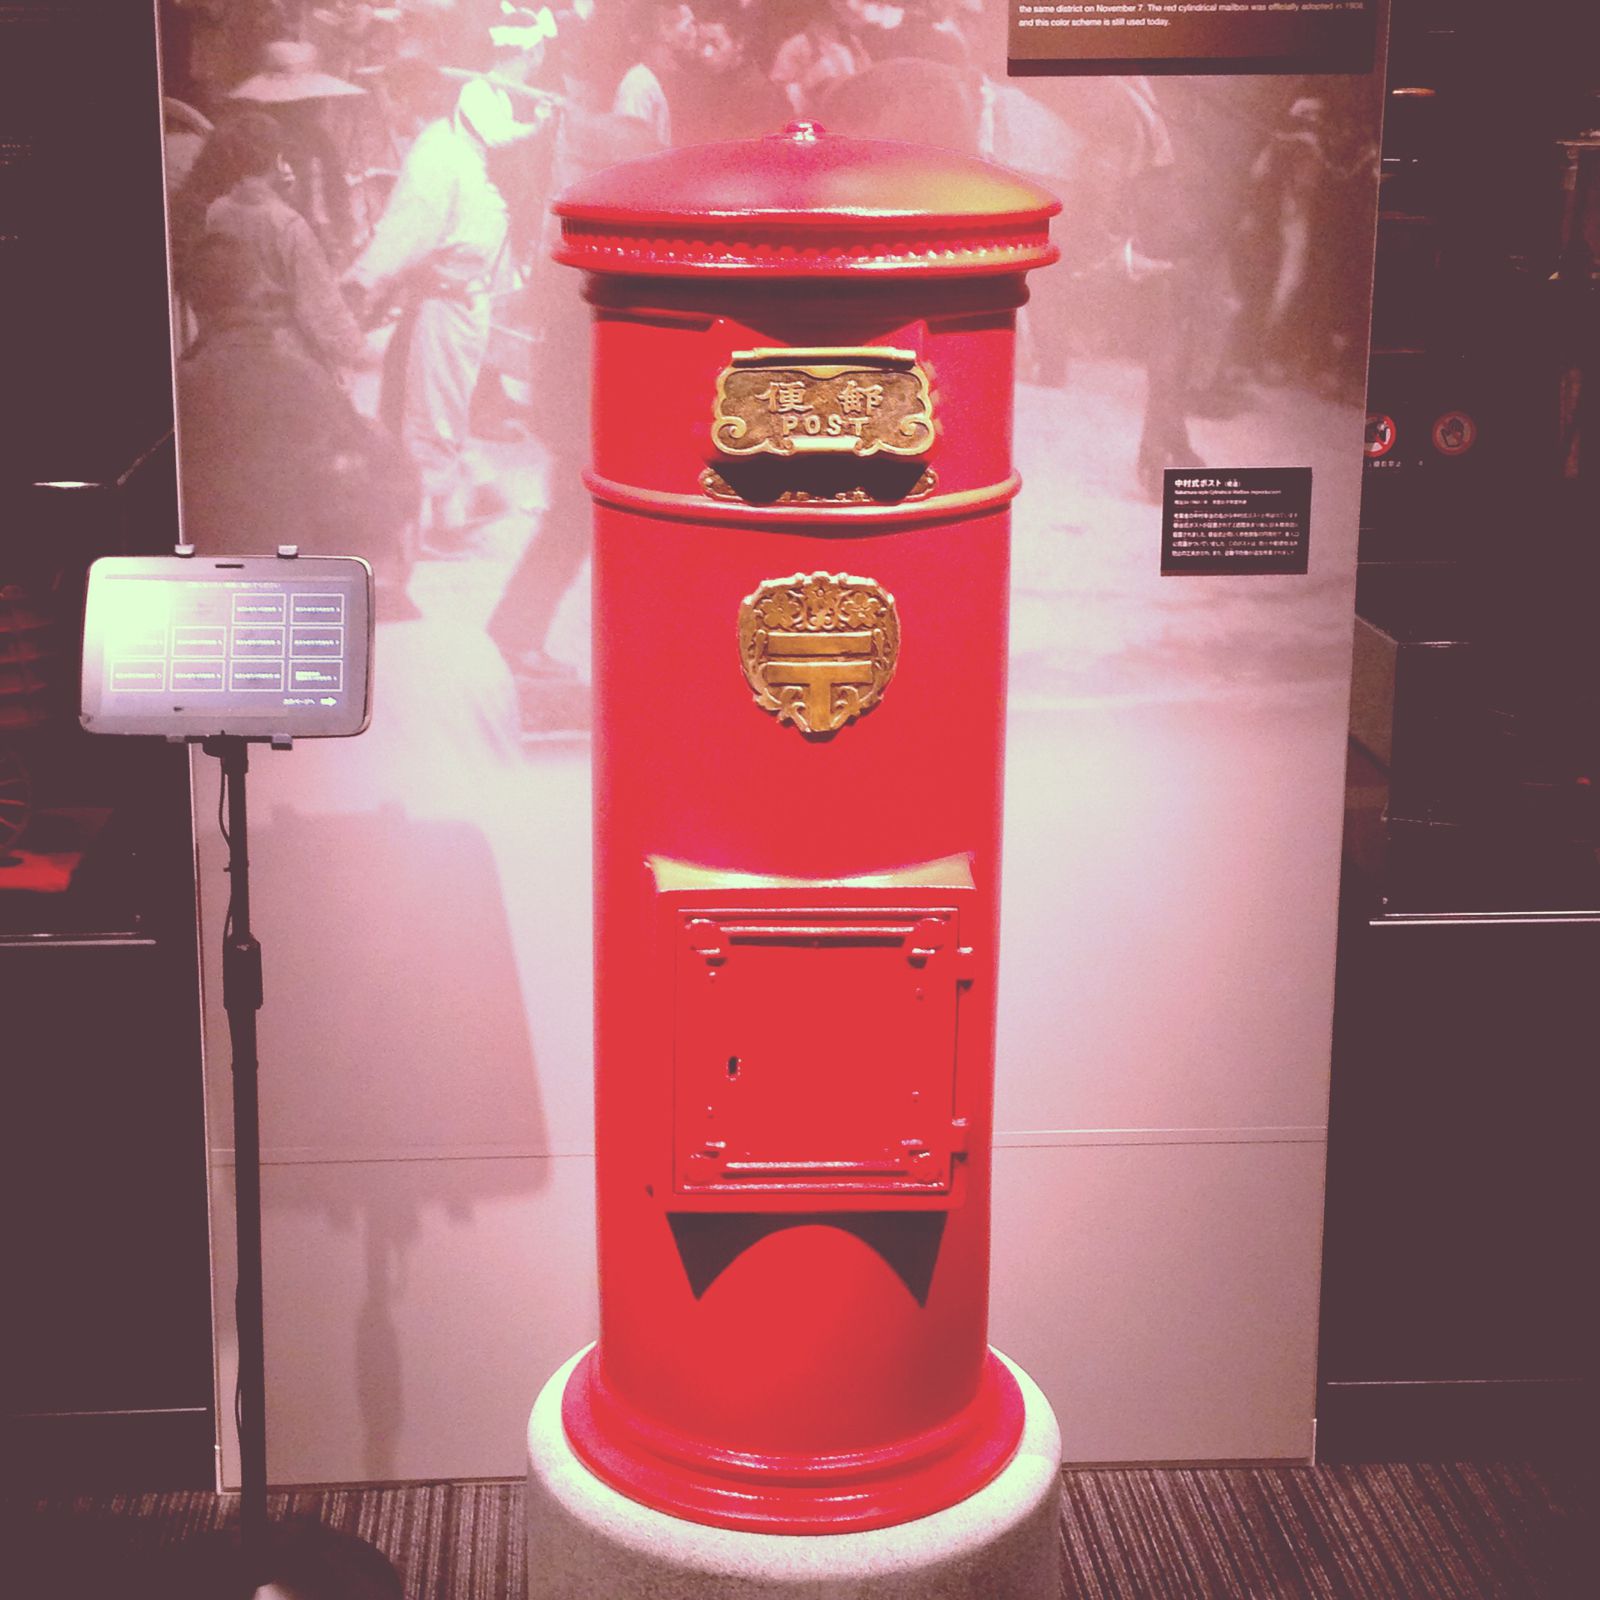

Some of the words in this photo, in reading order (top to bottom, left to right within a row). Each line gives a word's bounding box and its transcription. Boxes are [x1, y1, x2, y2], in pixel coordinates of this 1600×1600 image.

[1018, 5, 1032, 13] the
[1055, 5, 1084, 13] district
[1096, 4, 1137, 12] November
[1178, 3, 1217, 13] cylindrical
[1218, 3, 1249, 11] mailbox
[1268, 3, 1299, 12] officially
[1301, 2, 1334, 10] adopted
[1071, 18, 1102, 26] scheme
[1103, 18, 1110, 26] is
[1111, 18, 1125, 26] still
[1126, 18, 1146, 26] used
[782, 414, 870, 436] POST
